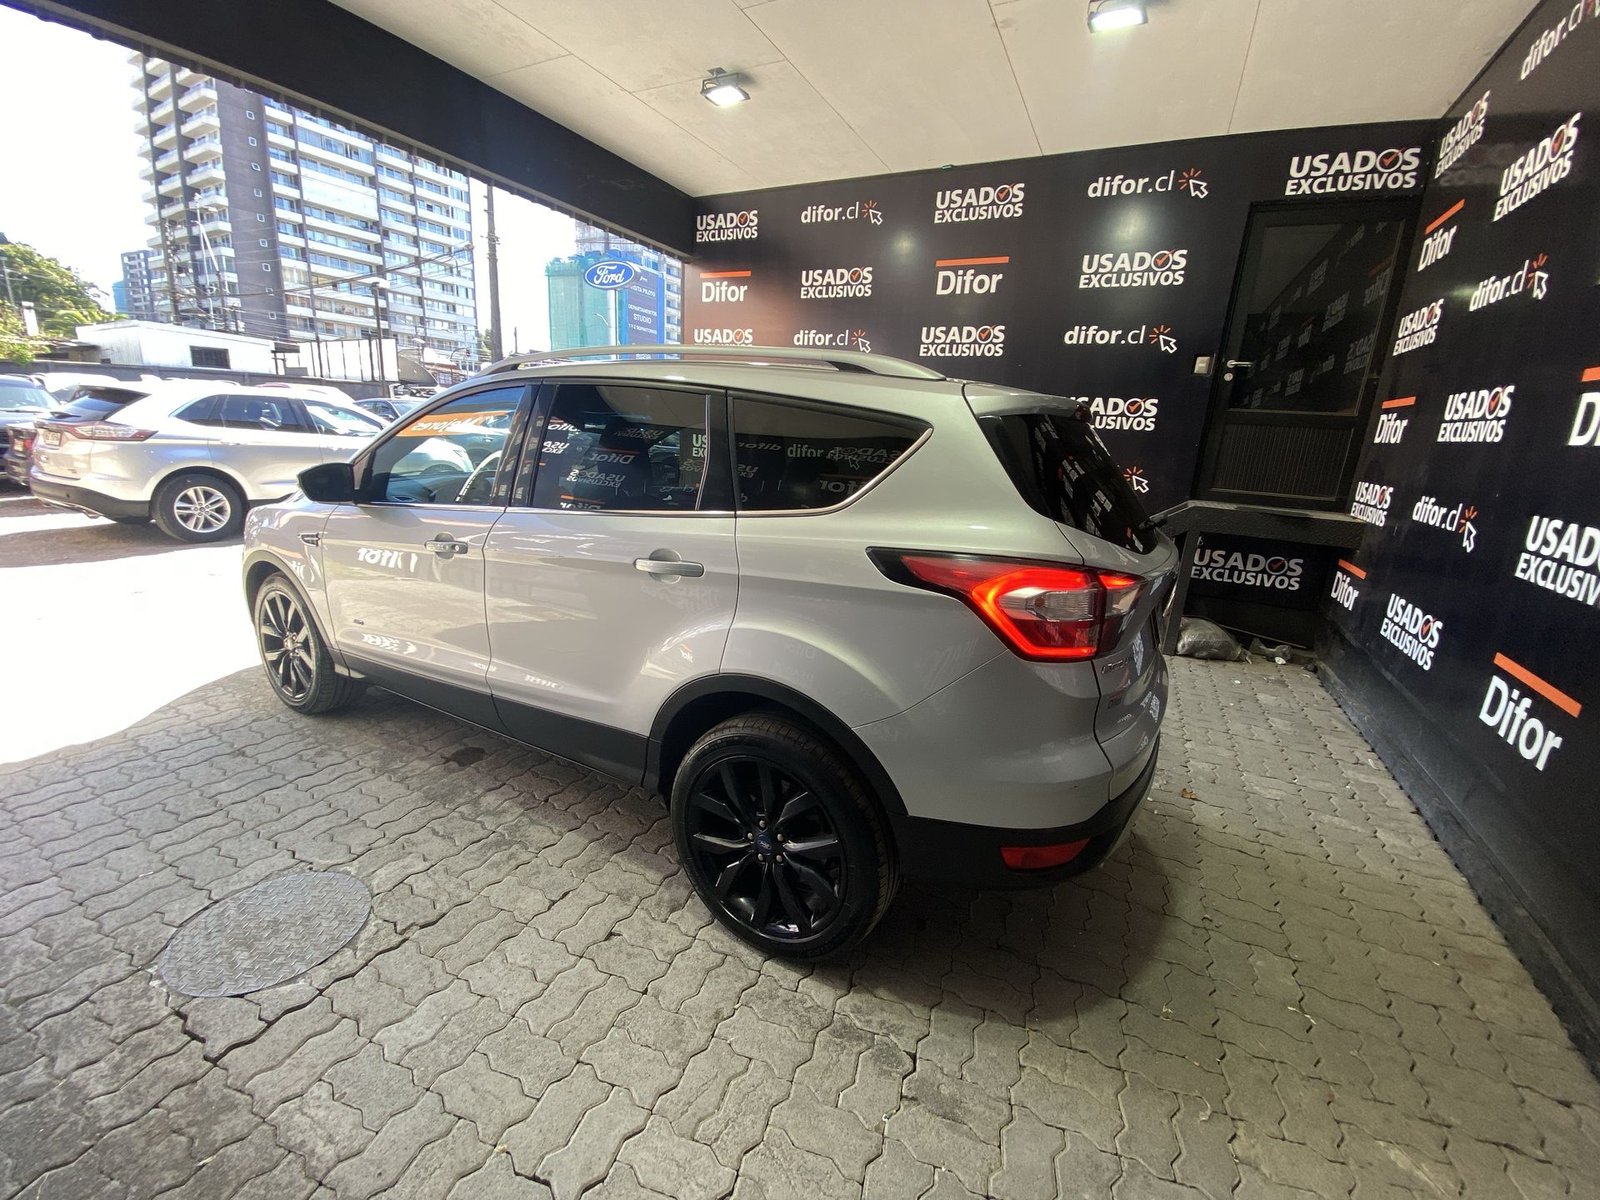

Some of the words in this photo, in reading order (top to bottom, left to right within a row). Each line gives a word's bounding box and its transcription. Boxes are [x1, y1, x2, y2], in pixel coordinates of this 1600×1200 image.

[1520, 0, 1585, 80] difor.cl
[1439, 90, 1490, 159] USADOS
[1434, 119, 1485, 179] EXCLUSIVOS
[1500, 112, 1582, 196] USADOS
[1289, 148, 1421, 178] USADOS
[936, 183, 1025, 209] USADOS
[1087, 170, 1175, 198] difor.cl
[1284, 171, 1417, 196] EXCLUSIVOS
[1492, 150, 1574, 222] EXCLUSIVOS
[696, 209, 758, 231] USADOS
[801, 201, 859, 224] difor.cl
[934, 202, 1024, 224] EXCLUSIVOS
[696, 226, 758, 243] EXCLUSIVOS
[1418, 225, 1458, 272] Difor
[593, 265, 625, 285] Ford
[1081, 249, 1188, 275] USADOS
[801, 266, 873, 287] USADOS
[936, 269, 1003, 296] Difor
[1078, 270, 1185, 289] EXCLUSIVOS
[1469, 259, 1530, 312] difor.cl
[701, 280, 748, 303] Difor
[800, 284, 872, 299] EXCLUSIVOS
[633, 313, 652, 324] STUDIO
[1398, 298, 1444, 338] USADOS
[694, 328, 753, 344] USADOS
[793, 329, 849, 346] difor.cl
[921, 325, 1005, 345] USADOS
[1064, 325, 1146, 345] difor.cl
[1393, 325, 1438, 356] EXCLUSIVOS
[919, 342, 1004, 357] EXCLUSIVOS
[1070, 396, 1159, 417] ADOS
[1444, 385, 1515, 421] USADOS
[1090, 416, 1156, 431] USIVOS
[1374, 413, 1408, 444] Difor
[1437, 419, 1506, 443] EXCLUSIVOS
[1355, 481, 1394, 510] USADOS
[1350, 502, 1387, 527] EXCLUSIVOS
[1412, 496, 1463, 532] difor.cl
[1526, 515, 1600, 571] USAD
[1193, 549, 1304, 577] USADOS
[1190, 566, 1300, 591] EXCLUSIVOS
[1331, 571, 1359, 611] Difor
[1514, 553, 1600, 609] EXCLUSIV
[1386, 593, 1443, 649] USADOS
[1380, 617, 1435, 671] EXCLUSIVOS
[1479, 675, 1563, 771] Difor
